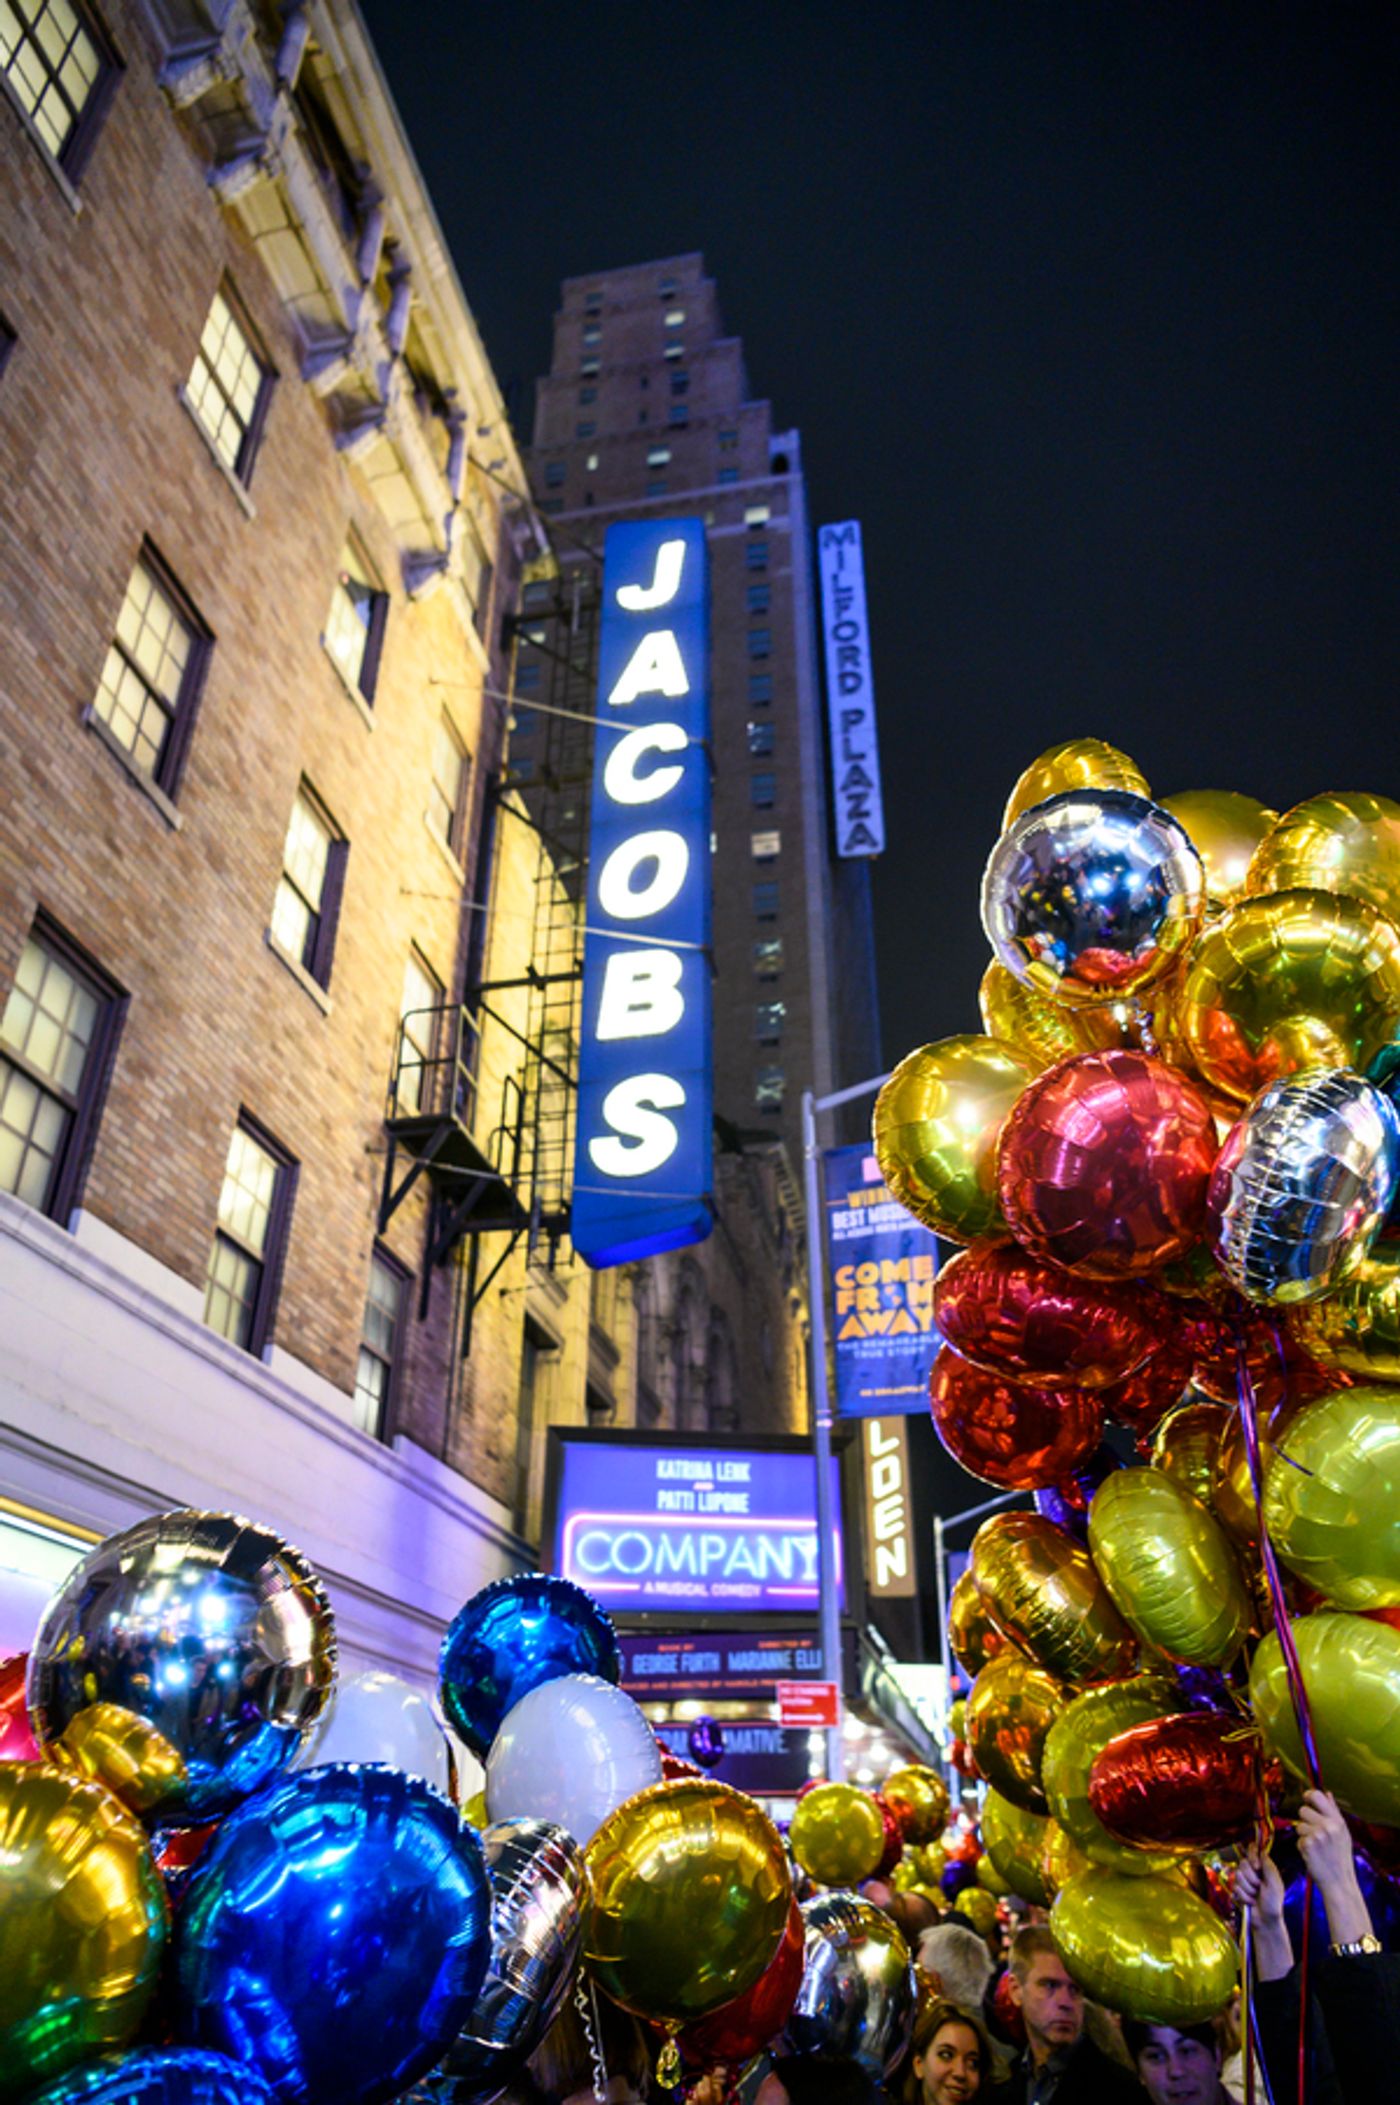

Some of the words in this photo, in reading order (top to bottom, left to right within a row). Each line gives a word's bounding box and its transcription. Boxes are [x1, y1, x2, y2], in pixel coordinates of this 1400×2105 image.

[823, 526, 862, 696] MILFORD
[840, 709, 878, 851] PLAZA
[589, 540, 689, 1177] JACOBS
[835, 1255, 934, 1291] COME
[836, 1281, 934, 1315] FROM
[837, 1306, 934, 1340] AWAY
[656, 1459, 713, 1480] KATRINA
[716, 1461, 752, 1482] LENK
[657, 1490, 695, 1511] PATTI
[870, 1420, 907, 1587] LDEN
[576, 1530, 818, 1580] COMPANY
[632, 1653, 679, 1674] GEORGE
[681, 1651, 721, 1673] FURTH
[728, 1650, 792, 1671] MARIANNE
[795, 1648, 823, 1670] ELLI
